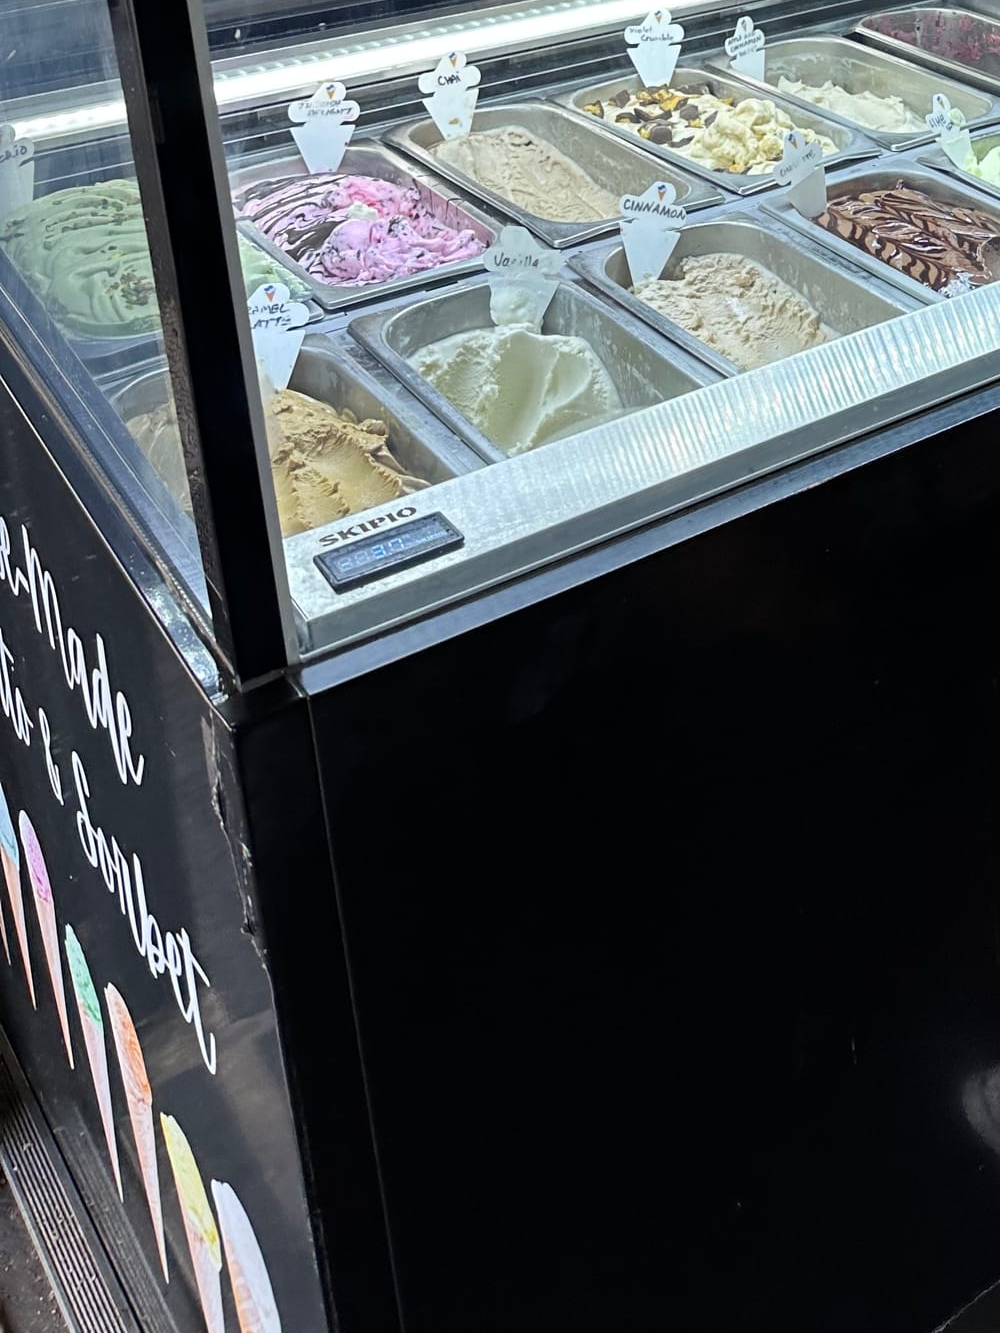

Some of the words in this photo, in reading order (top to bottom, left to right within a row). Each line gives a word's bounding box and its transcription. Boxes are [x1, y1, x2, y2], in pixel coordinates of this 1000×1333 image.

[623, 198, 687, 221] CINNAMON
[318, 506, 417, 547] SKIPIO
[39, 707, 64, 806] &
[72, 752, 216, 1076] Sorbet
